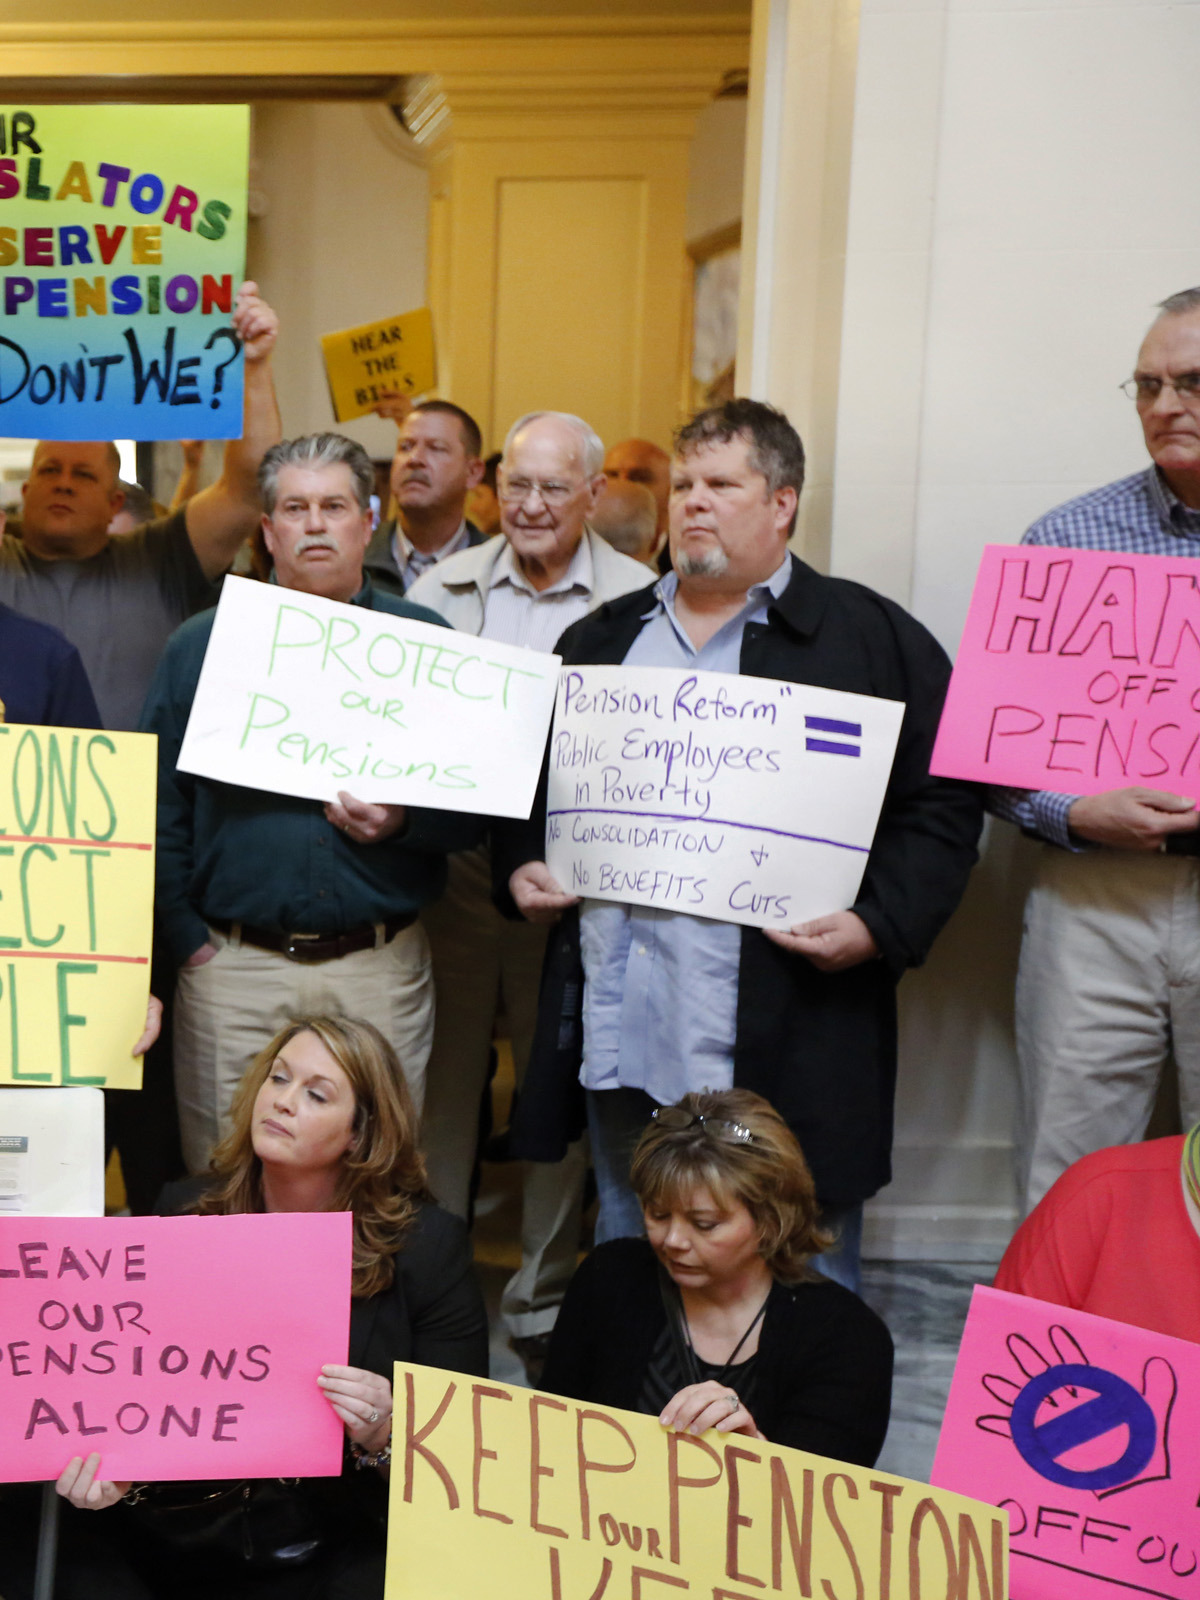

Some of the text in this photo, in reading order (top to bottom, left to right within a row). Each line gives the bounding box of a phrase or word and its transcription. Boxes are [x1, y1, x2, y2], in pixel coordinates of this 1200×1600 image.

[4, 274, 233, 318] PENSION
[350, 325, 402, 356] HEAR
[362, 352, 400, 377] THE
[122, 326, 243, 410] WE?
[268, 604, 544, 710] PROTECT
[1087, 670, 1178, 709] OFF
[240, 692, 477, 789] Pensions
[555, 728, 781, 785] Public Employees
[601, 766, 711, 819] Poverty
[571, 817, 724, 854] CONSOLIDATION
[599, 863, 708, 904] BENEFITS
[729, 881, 792, 918] CUTS
[38, 1300, 151, 1335] OUR
[25, 1398, 244, 1441] ALONE
[403, 1372, 637, 1540] KEEP
[599, 1512, 663, 1559] OUR
[996, 1498, 1131, 1554] OFF
